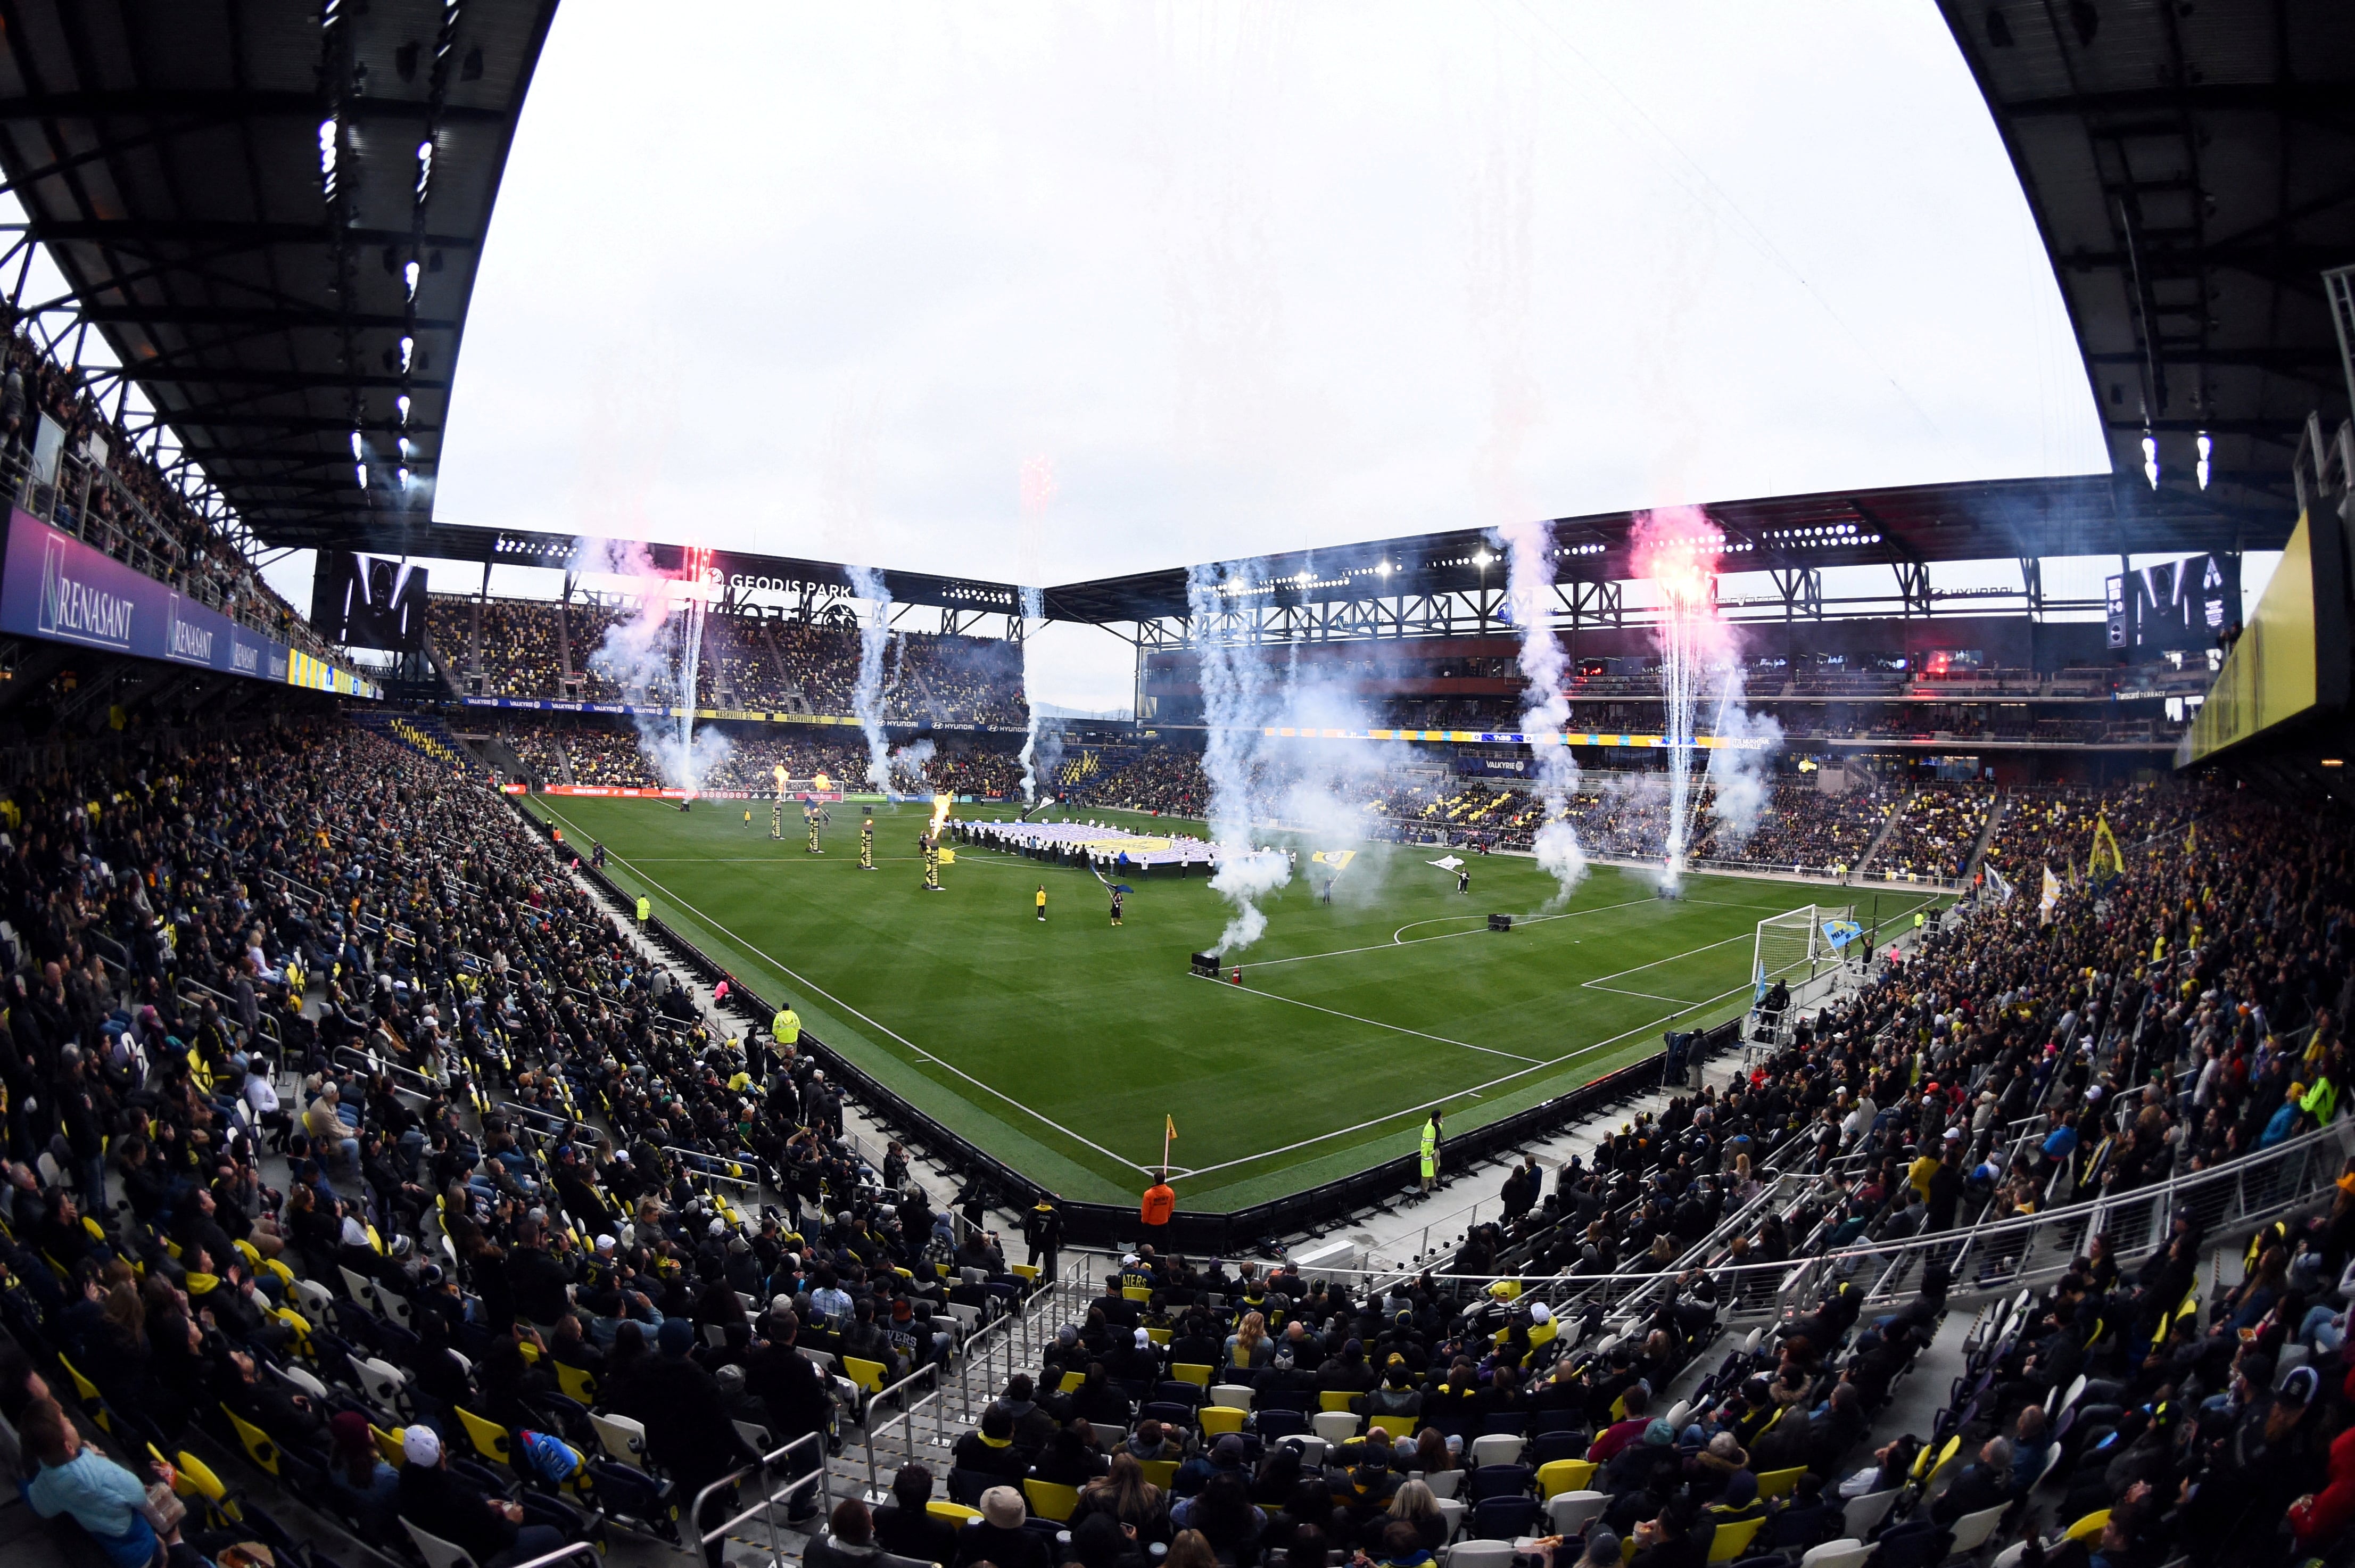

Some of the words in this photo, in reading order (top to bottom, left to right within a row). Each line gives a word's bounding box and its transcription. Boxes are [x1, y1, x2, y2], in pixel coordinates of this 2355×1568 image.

[730, 574, 800, 594] GEODIS
[806, 582, 852, 599] PARK
[58, 577, 134, 640] RENASANT
[175, 620, 213, 659] RENASANT
[1486, 760, 1515, 769] VALKYRIE
[1831, 928, 1845, 940] MIX
[790, 1169, 800, 1181] 8
[1039, 1221, 1048, 1233] 7
[588, 1267, 597, 1286] 2
